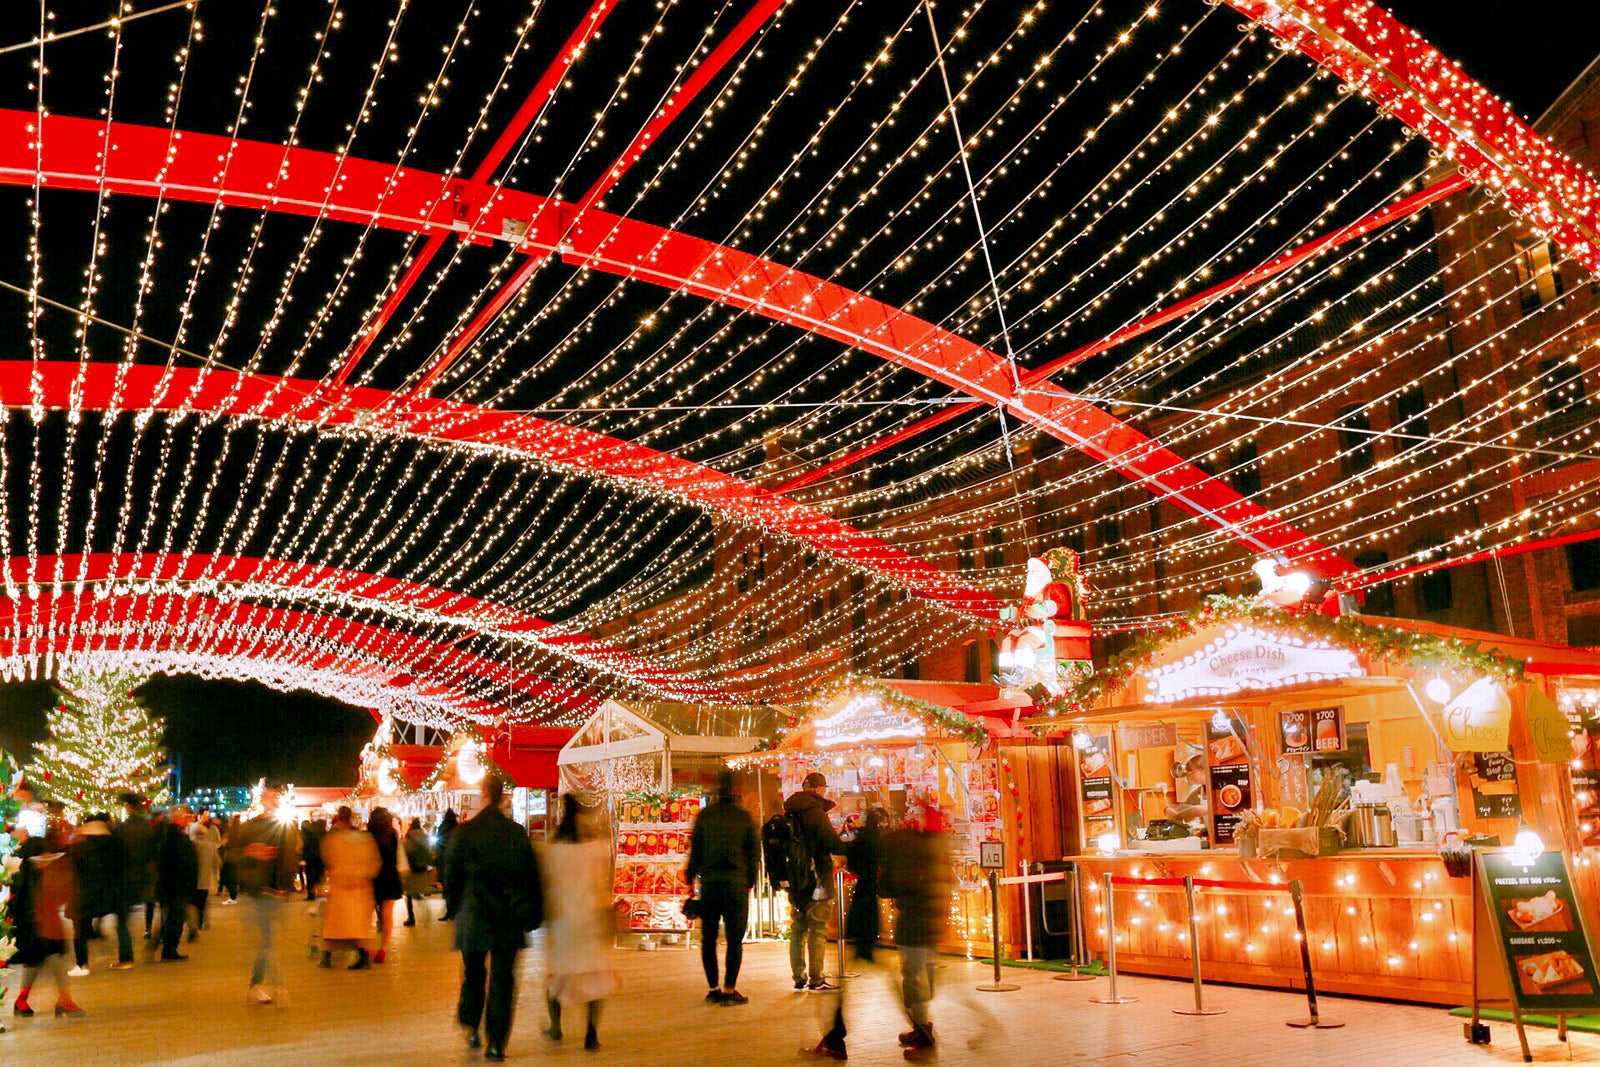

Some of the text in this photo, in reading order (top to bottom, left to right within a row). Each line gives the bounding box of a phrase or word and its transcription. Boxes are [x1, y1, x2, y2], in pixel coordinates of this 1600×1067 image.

[1209, 645, 1285, 671] Cheese Dish
[1228, 666, 1267, 678] Factory
[1316, 710, 1335, 720] ¥700
[1448, 706, 1503, 742] Cheese
[1127, 728, 1169, 745] ORDER
[1316, 737, 1339, 750] BEER
